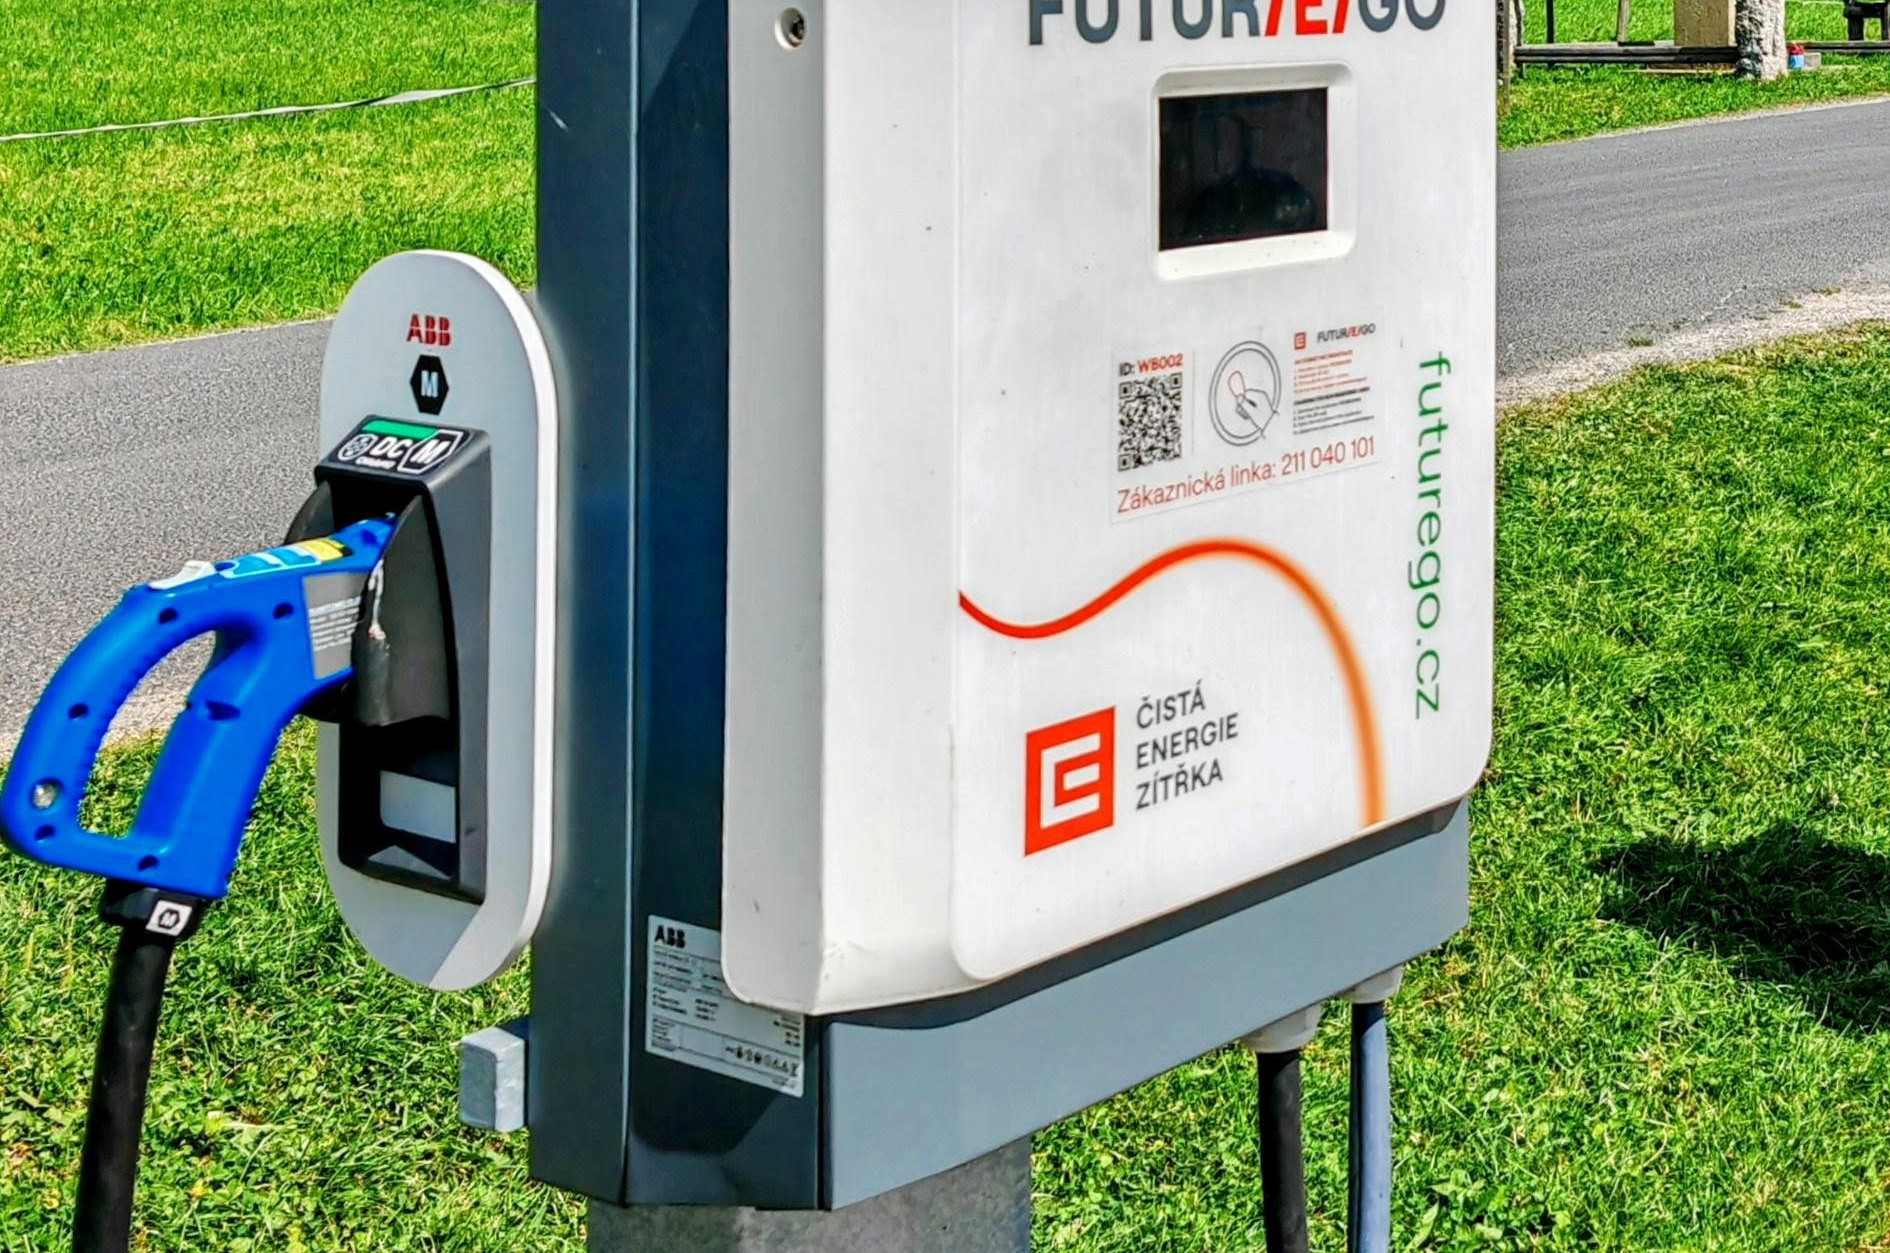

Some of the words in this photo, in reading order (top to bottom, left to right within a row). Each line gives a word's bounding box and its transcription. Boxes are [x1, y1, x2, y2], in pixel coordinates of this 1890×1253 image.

[407, 314, 452, 347] ABB
[421, 370, 439, 398] M
[1119, 361, 1135, 377] ID:
[1137, 353, 1184, 375] WB002
[369, 436, 414, 459] DC
[1117, 468, 1225, 514] Zákaznická
[1230, 458, 1276, 485] linka:
[1281, 452, 1306, 476] 211
[1310, 444, 1346, 469] 040
[1351, 436, 1374, 459] 101
[1406, 351, 1451, 720] futurego.cz
[1136, 678, 1206, 730] ČISTÁ
[1136, 712, 1239, 770] ENERGIE
[1135, 757, 1224, 811] ZÍTŘKA
[654, 925, 686, 949] ABB
